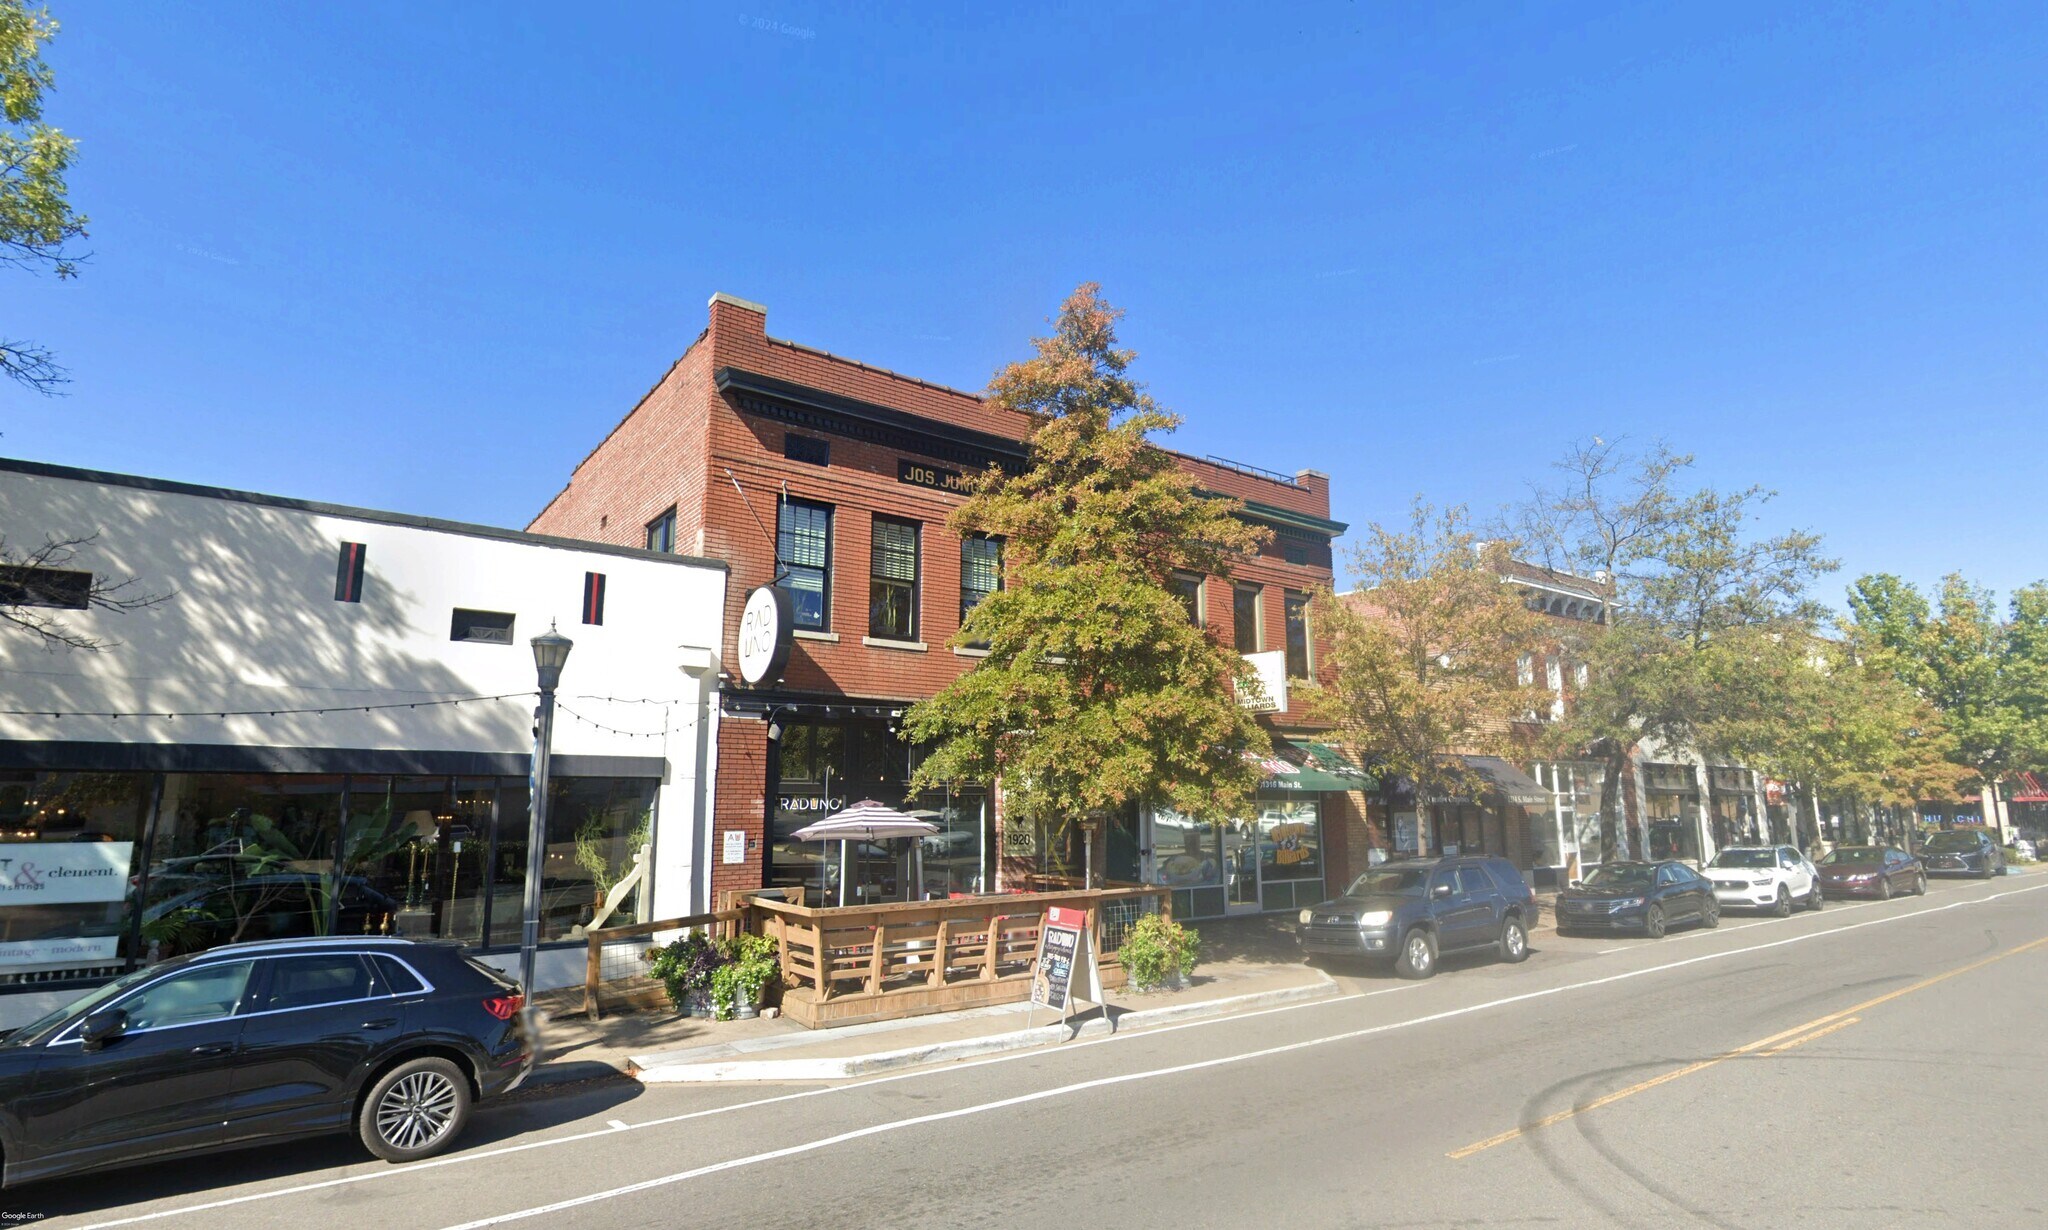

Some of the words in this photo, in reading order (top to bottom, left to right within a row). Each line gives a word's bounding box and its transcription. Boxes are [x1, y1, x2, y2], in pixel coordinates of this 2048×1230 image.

[904, 466, 939, 486] JOS.
[941, 474, 980, 494] JUNG
[1237, 696, 1274, 705] MIDTOWN
[1278, 781, 1293, 789] Main
[1293, 781, 1303, 789] St.
[780, 797, 840, 811] RADUNO
[1008, 833, 1031, 846] 1920
[14, 861, 45, 886] &
[48, 866, 118, 878] clement.
[0, 948, 39, 958] intage
[51, 943, 102, 955] modern
